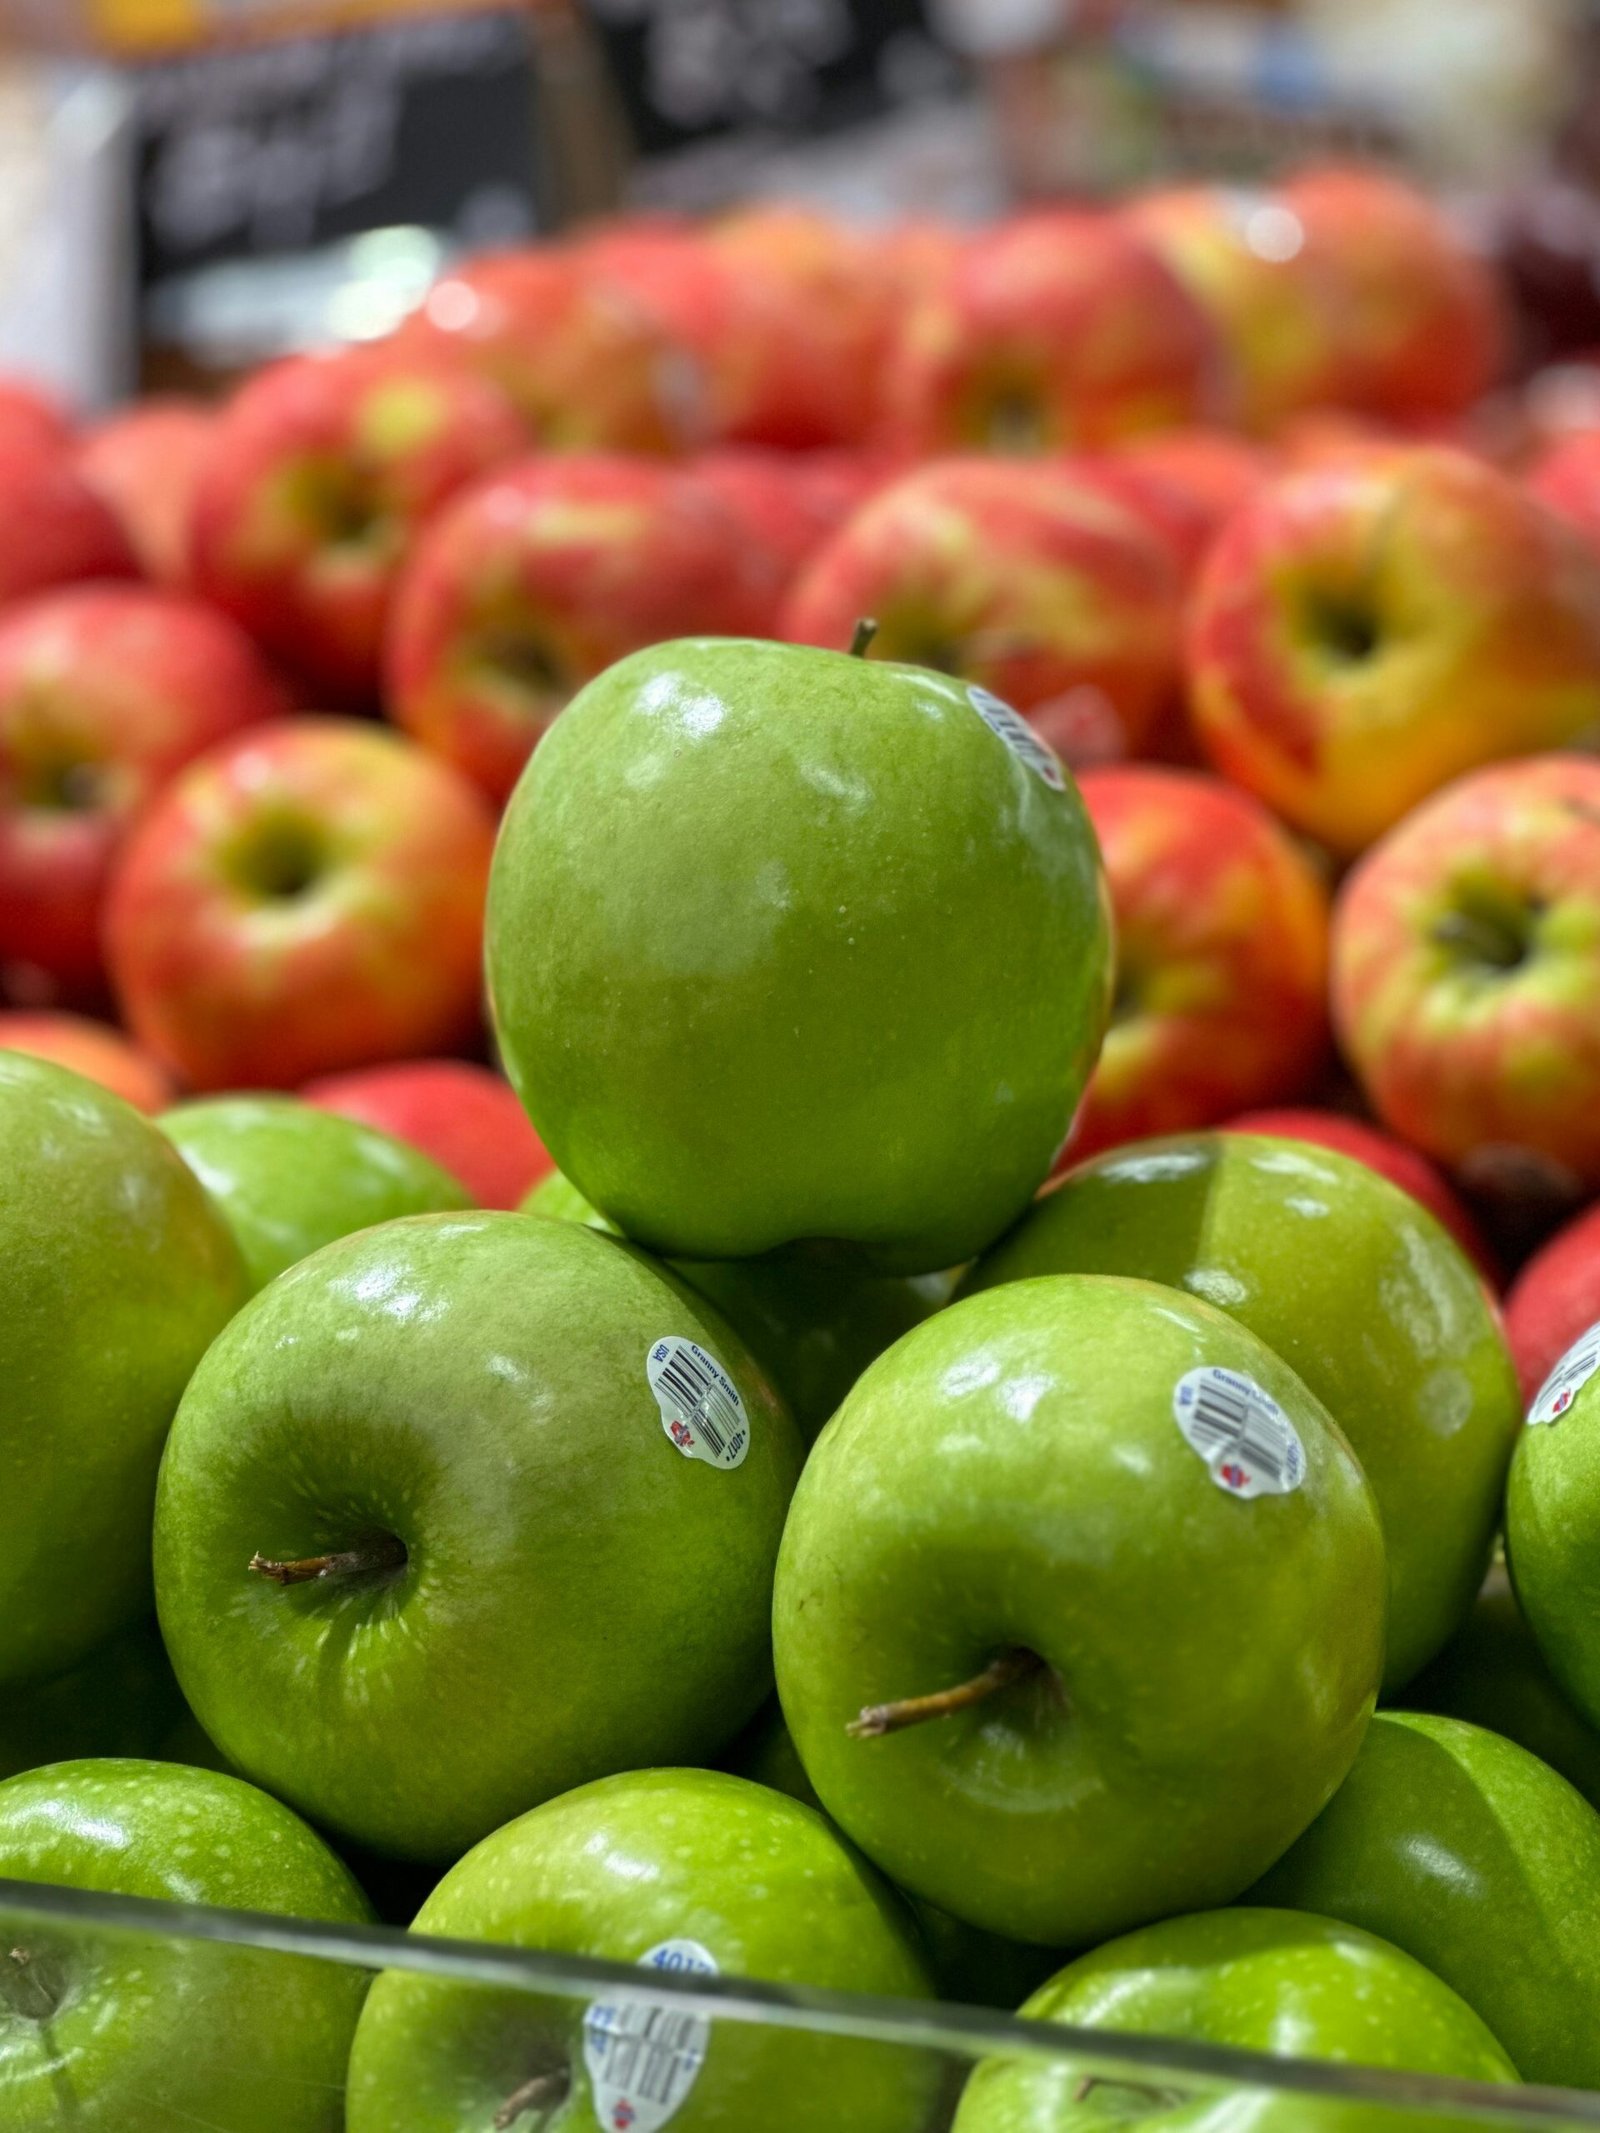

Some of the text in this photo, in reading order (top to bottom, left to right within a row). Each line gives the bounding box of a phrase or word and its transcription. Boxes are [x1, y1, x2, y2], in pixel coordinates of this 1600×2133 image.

[653, 1344, 669, 1362] USA
[691, 1344, 739, 1406] Granny Smith
